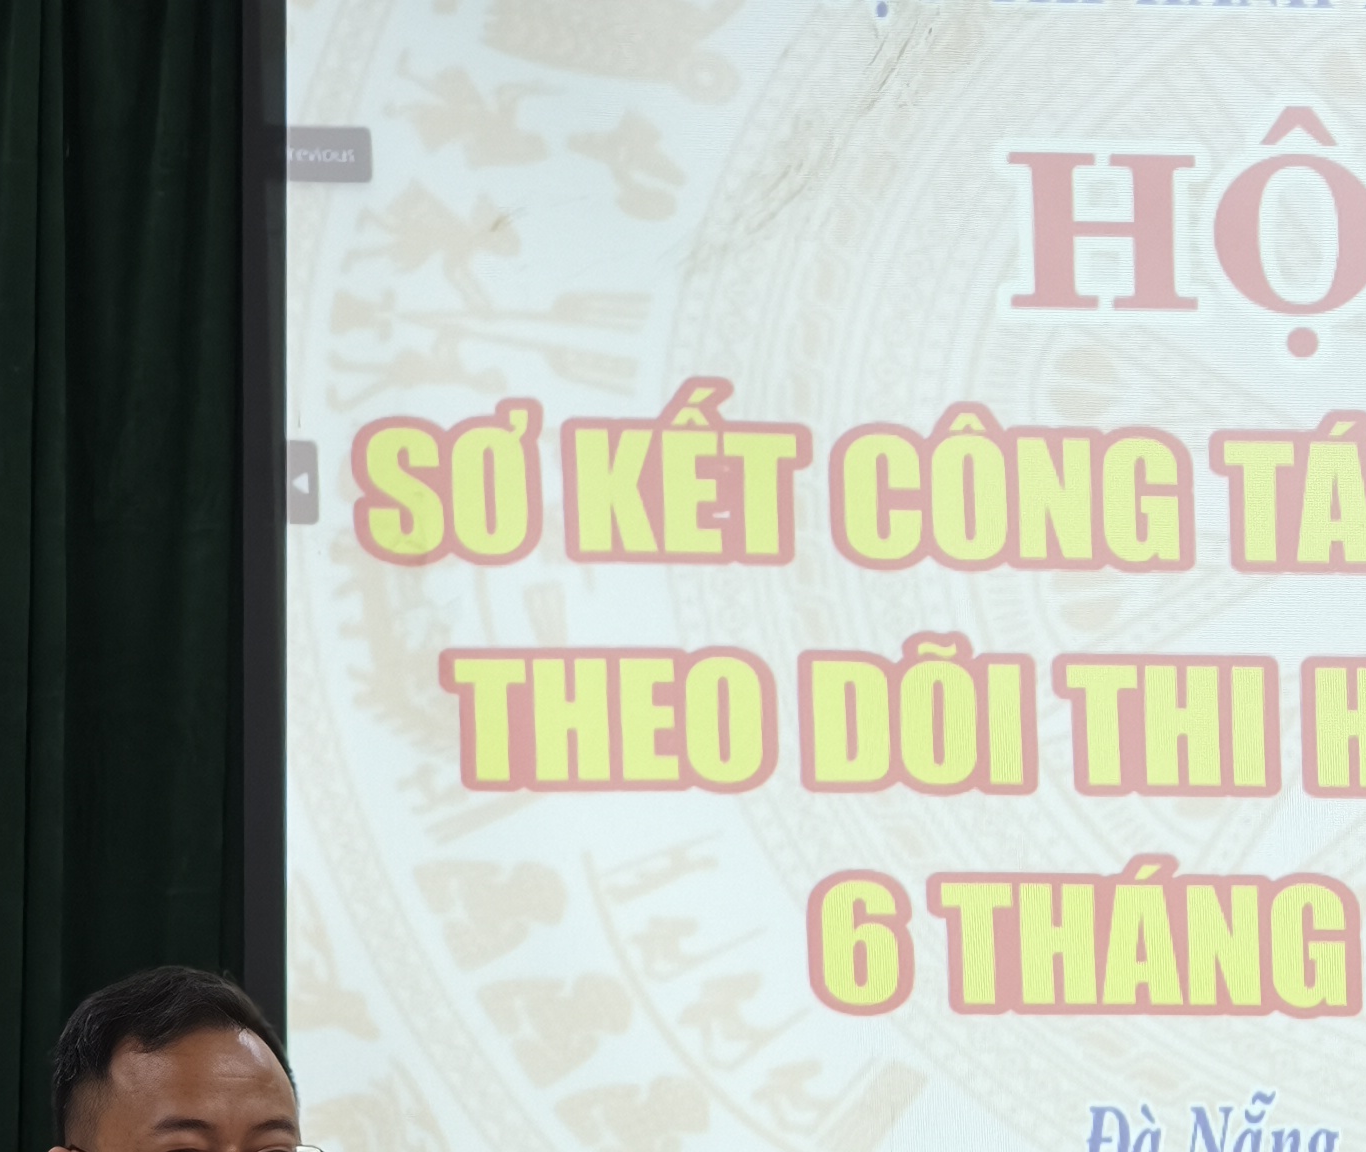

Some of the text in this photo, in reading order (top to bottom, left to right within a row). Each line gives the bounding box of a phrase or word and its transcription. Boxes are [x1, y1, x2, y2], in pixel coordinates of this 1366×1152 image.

[350, 398, 543, 568] SƠ
[560, 377, 813, 567] KẾT
[828, 402, 1195, 574] CÔNG
[438, 646, 778, 795] THEO
[797, 632, 1038, 797] DÕI
[1051, 653, 1281, 798] THI
[806, 870, 914, 1017] 6
[925, 854, 1363, 1020] THÁNG
